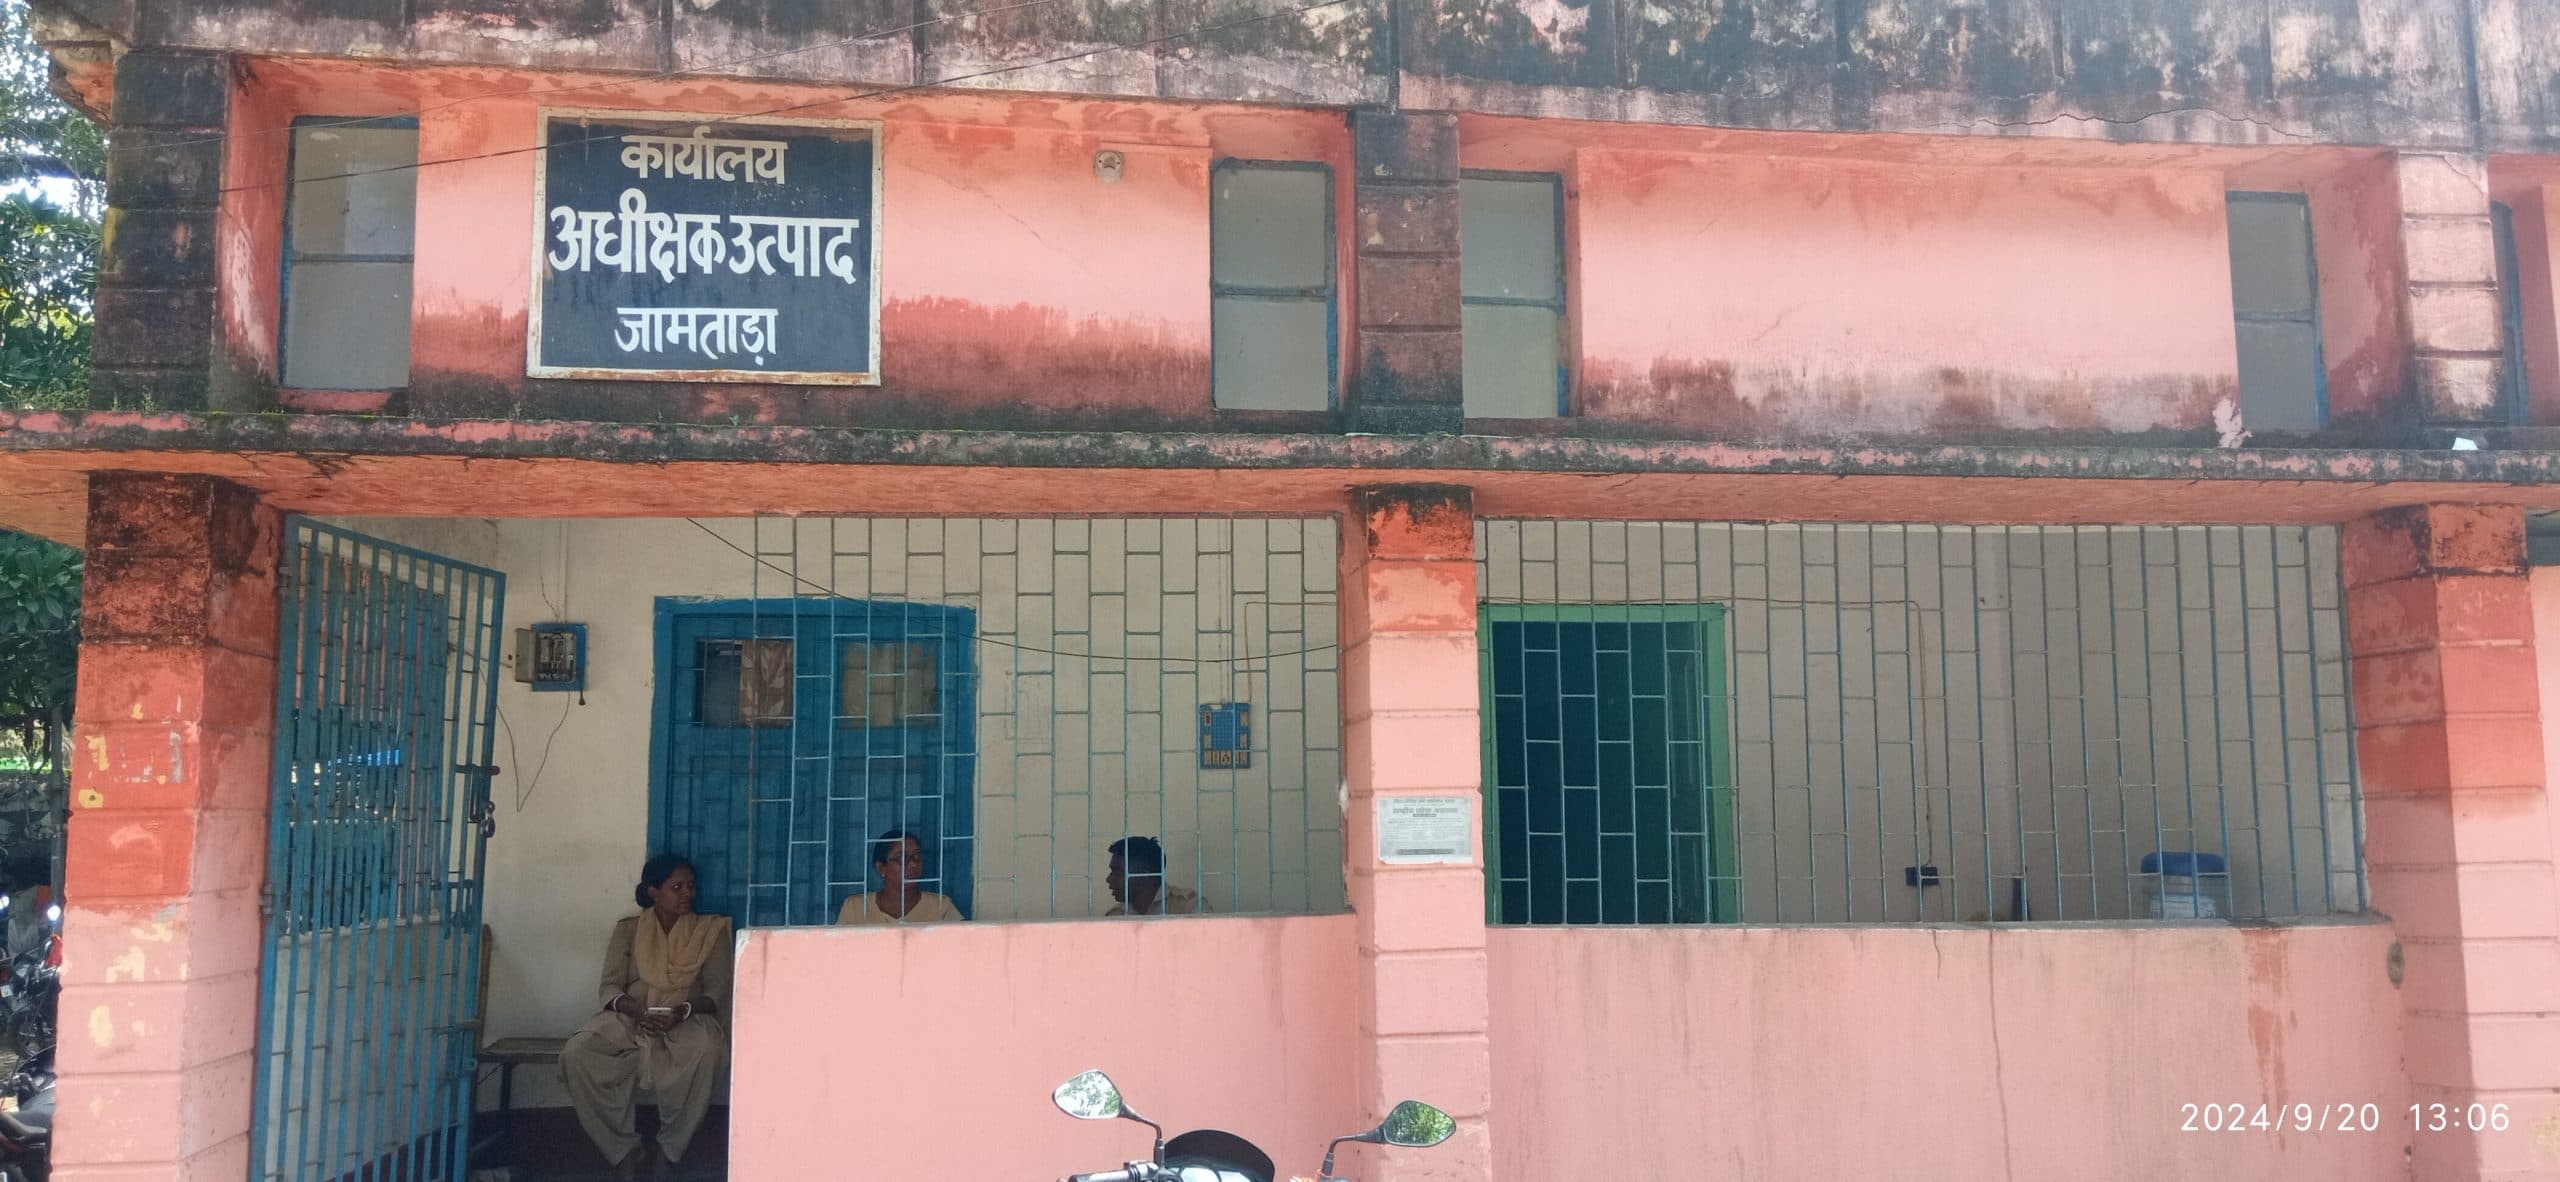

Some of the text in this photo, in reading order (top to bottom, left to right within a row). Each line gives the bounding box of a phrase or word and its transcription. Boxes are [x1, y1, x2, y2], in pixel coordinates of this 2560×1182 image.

[621, 125, 789, 185] कार्यालय
[548, 187, 860, 285] अधीक्षक उत्पाद
[614, 306, 779, 366] जामताड़ा
